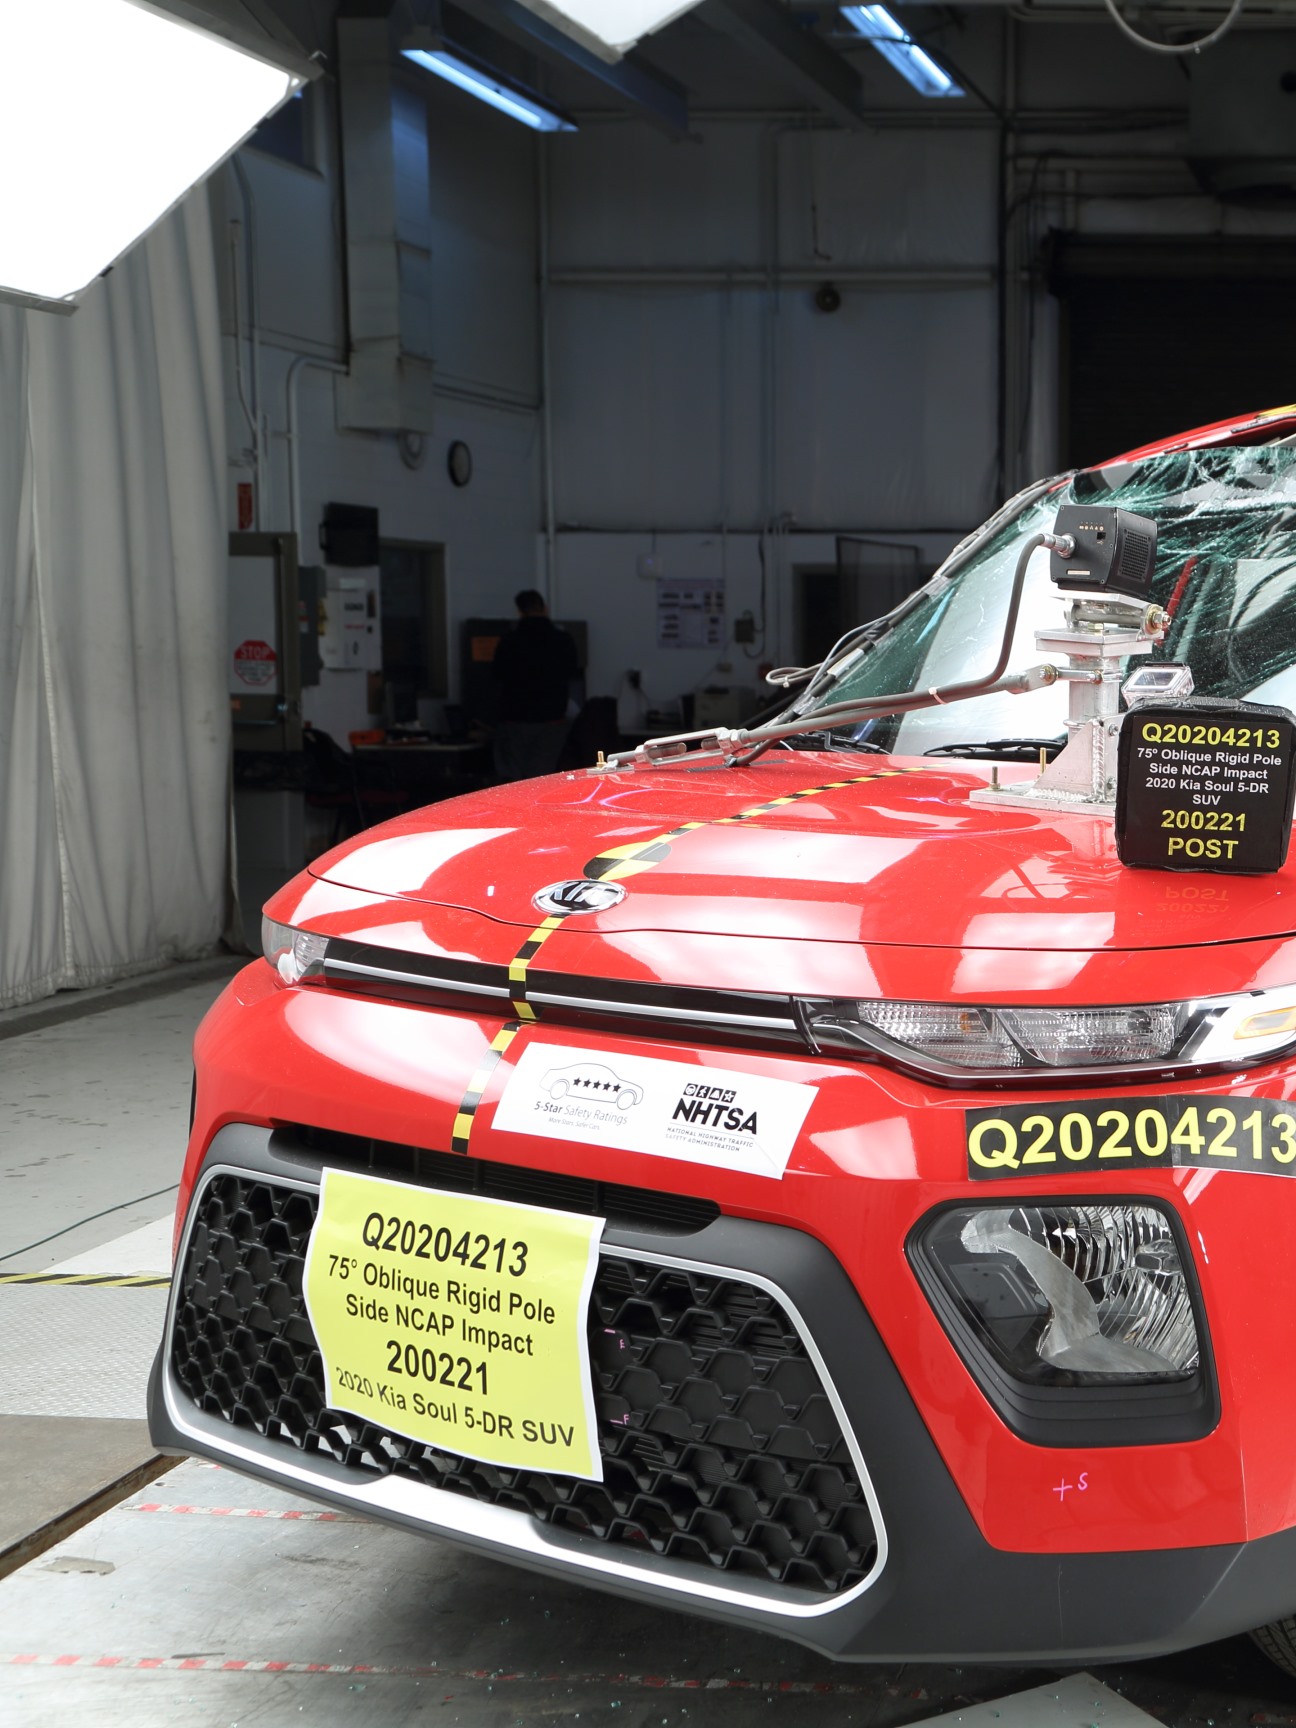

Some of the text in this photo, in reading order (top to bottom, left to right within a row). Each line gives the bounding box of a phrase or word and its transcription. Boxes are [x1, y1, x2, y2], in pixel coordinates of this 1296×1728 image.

[240, 645, 270, 659] STOP
[1142, 723, 1280, 748] Q20204213
[1161, 749, 1212, 763] Oblique
[1215, 752, 1249, 766] Rigid
[1253, 753, 1282, 766] Pole
[1149, 763, 1268, 780] Side NCAP Impact
[1145, 777, 1269, 793] 2020 Kia Soul 5-DR
[1192, 794, 1221, 806] SUV
[1161, 810, 1246, 832] 200221
[1168, 838, 1238, 859] POST
[534, 1101, 628, 1127] 5-Star Safety Ratings
[672, 1097, 757, 1135] NHTSA
[665, 1133, 740, 1152] SAFETY ADMINISTRATION
[667, 1127, 754, 1148] NATIONAL HIGHWAY TRAFFIC
[968, 1106, 1296, 1170] Q20204213
[362, 1212, 528, 1277] Q20204213
[363, 1262, 440, 1300] Oblique
[446, 1280, 501, 1314] Rigid
[509, 1293, 555, 1325] Pole
[346, 1293, 534, 1356] Side NCAP Impact
[386, 1340, 488, 1396] 200221
[335, 1366, 575, 1447] 2020 Kia Soul 5-DR SUV
